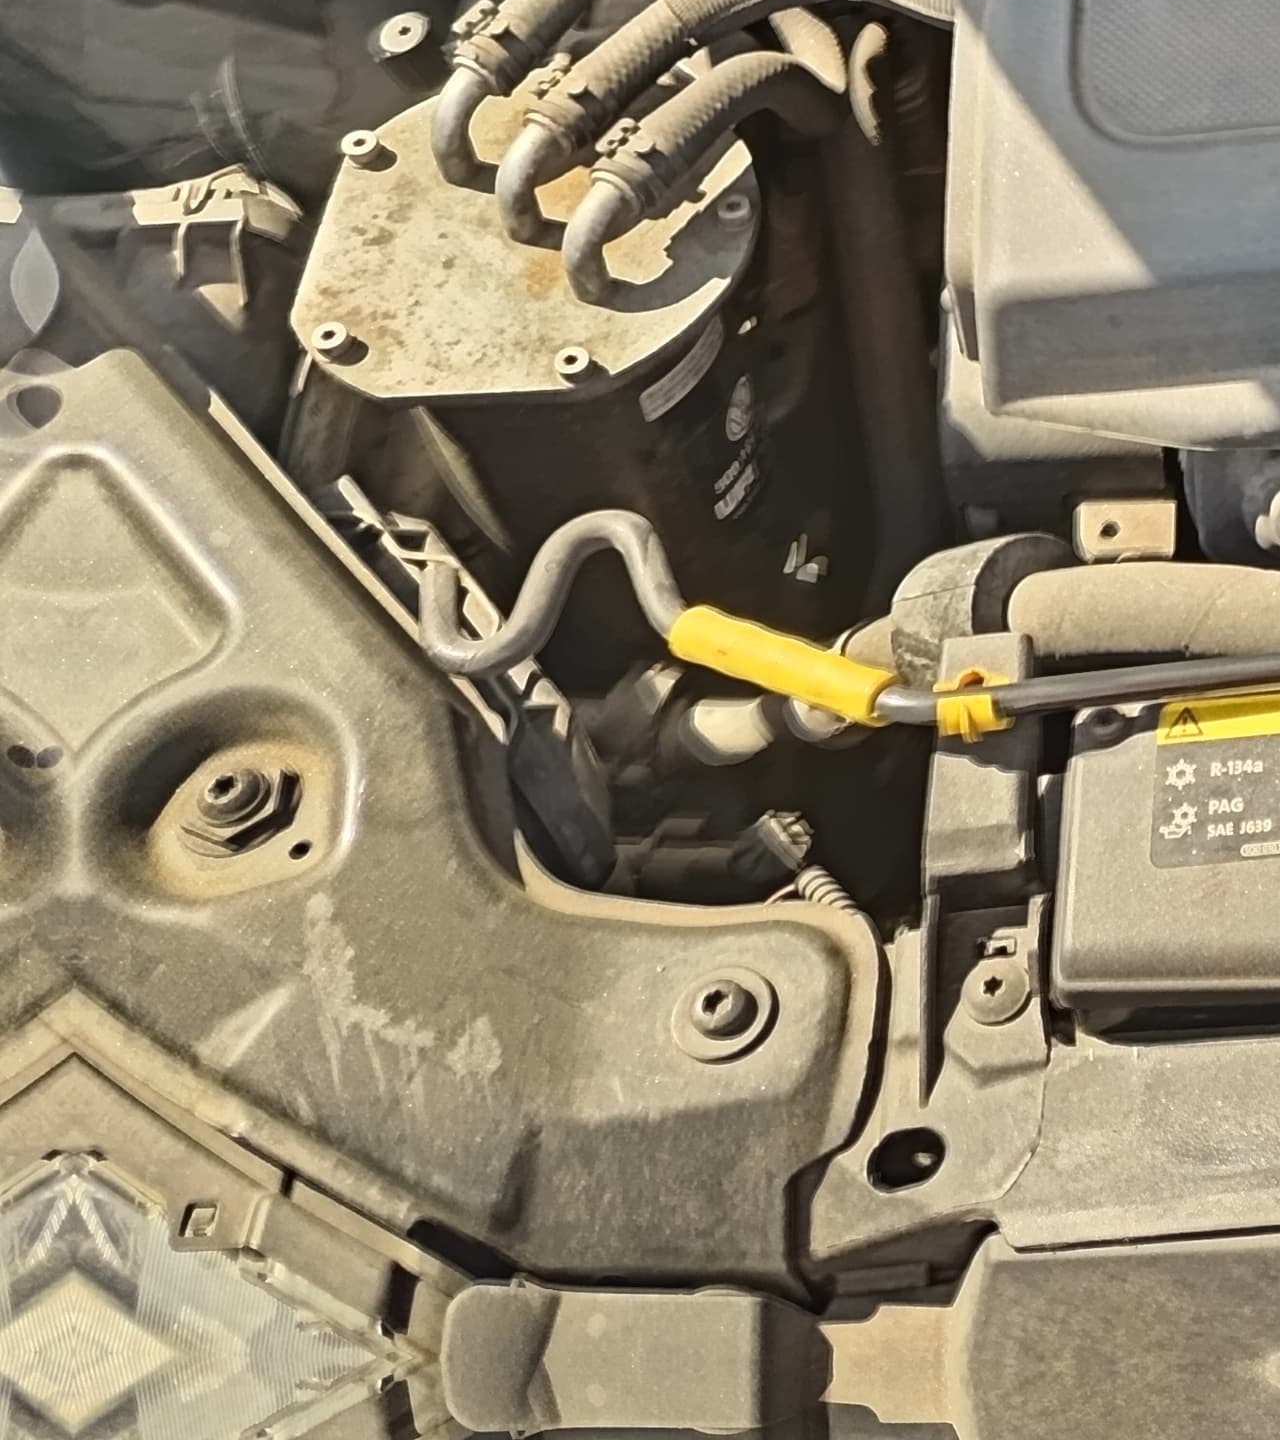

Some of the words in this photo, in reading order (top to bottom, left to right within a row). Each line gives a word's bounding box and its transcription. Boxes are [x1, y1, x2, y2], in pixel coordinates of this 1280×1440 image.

[1210, 759, 1264, 777] R-134a
[1208, 797, 1244, 815] PAG
[1207, 822, 1234, 839] SAE
[1240, 818, 1272, 835] J639
